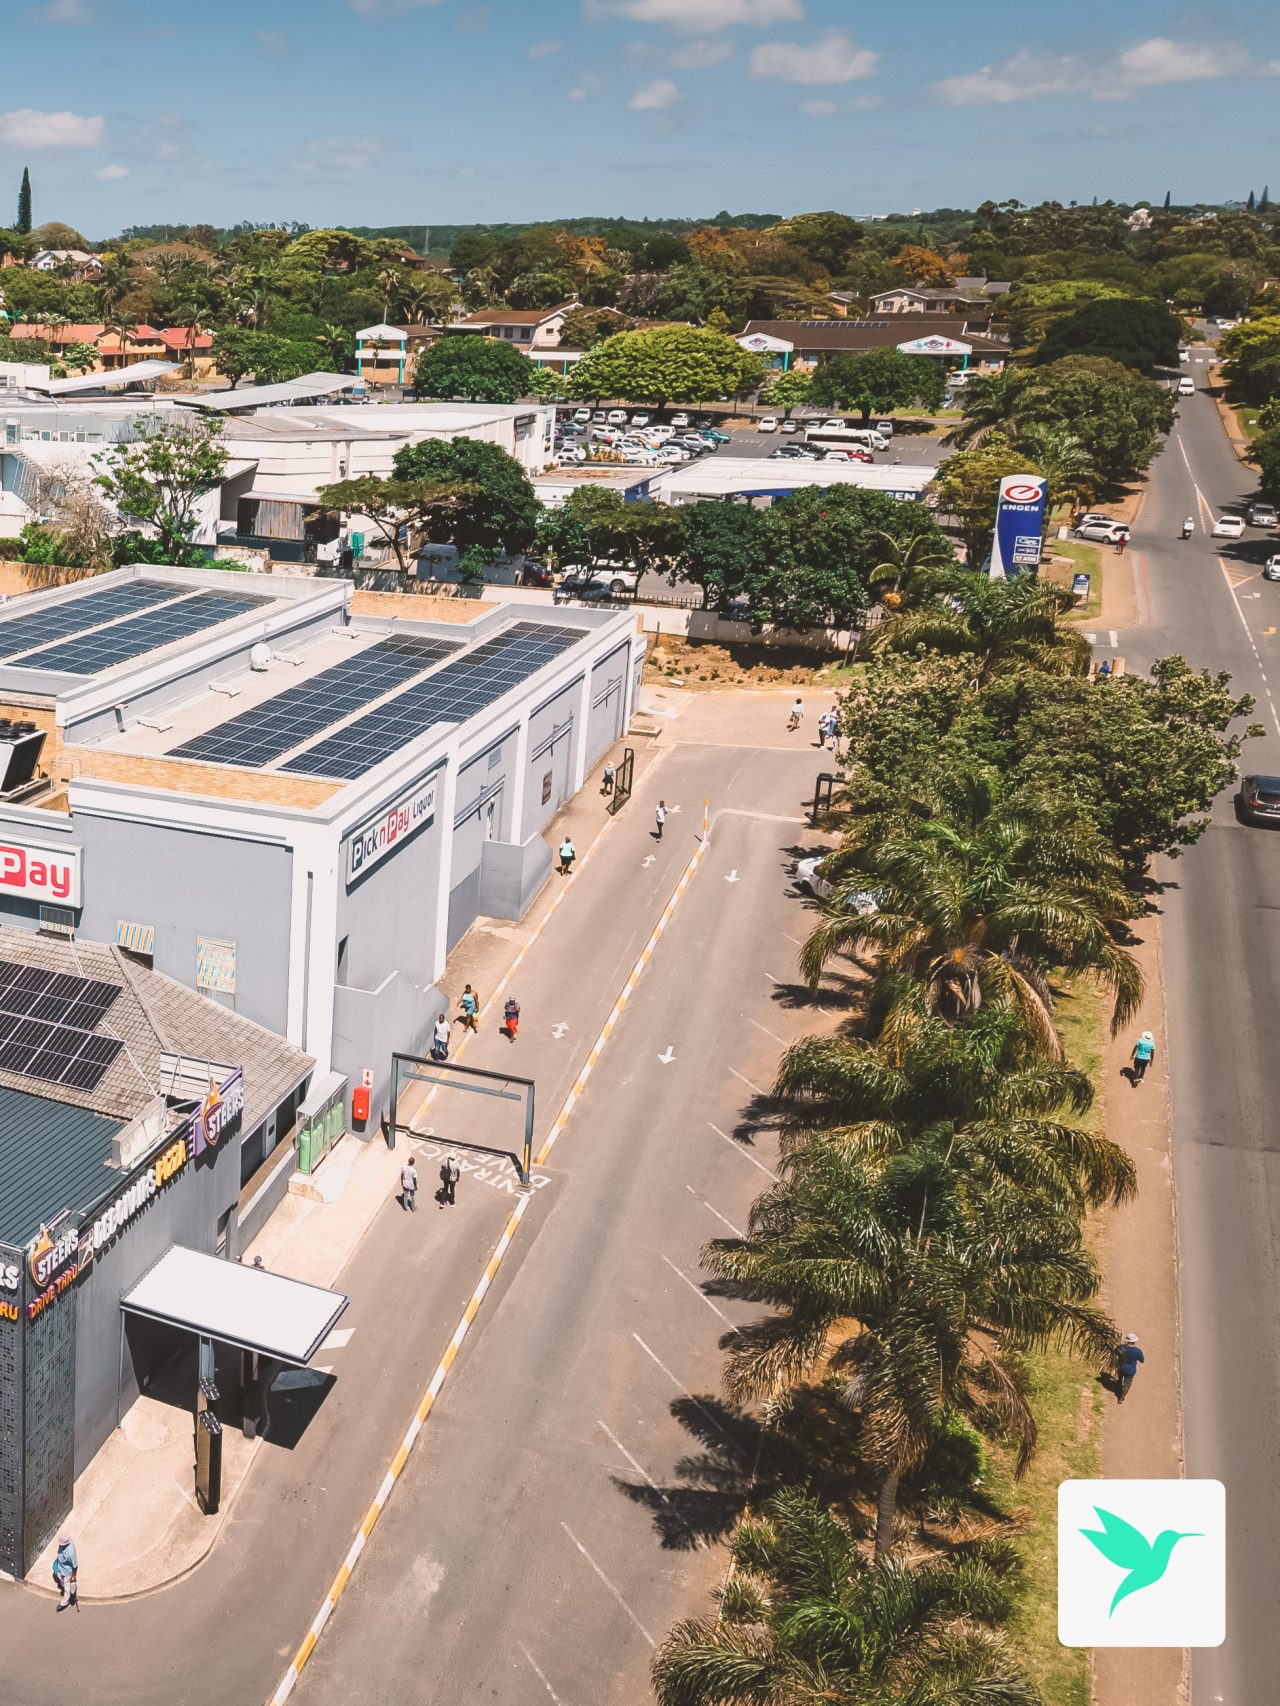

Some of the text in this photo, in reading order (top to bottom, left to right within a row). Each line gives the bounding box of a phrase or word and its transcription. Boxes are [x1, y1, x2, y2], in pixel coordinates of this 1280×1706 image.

[1002, 504, 1039, 512] ENGEN
[352, 790, 435, 873] Pick n Pay Liquor
[208, 1088, 245, 1139] STEERS
[155, 1139, 188, 1187] PIZZA
[38, 1229, 79, 1282] STEERS
[28, 1264, 78, 1319] DRIVE THRU
